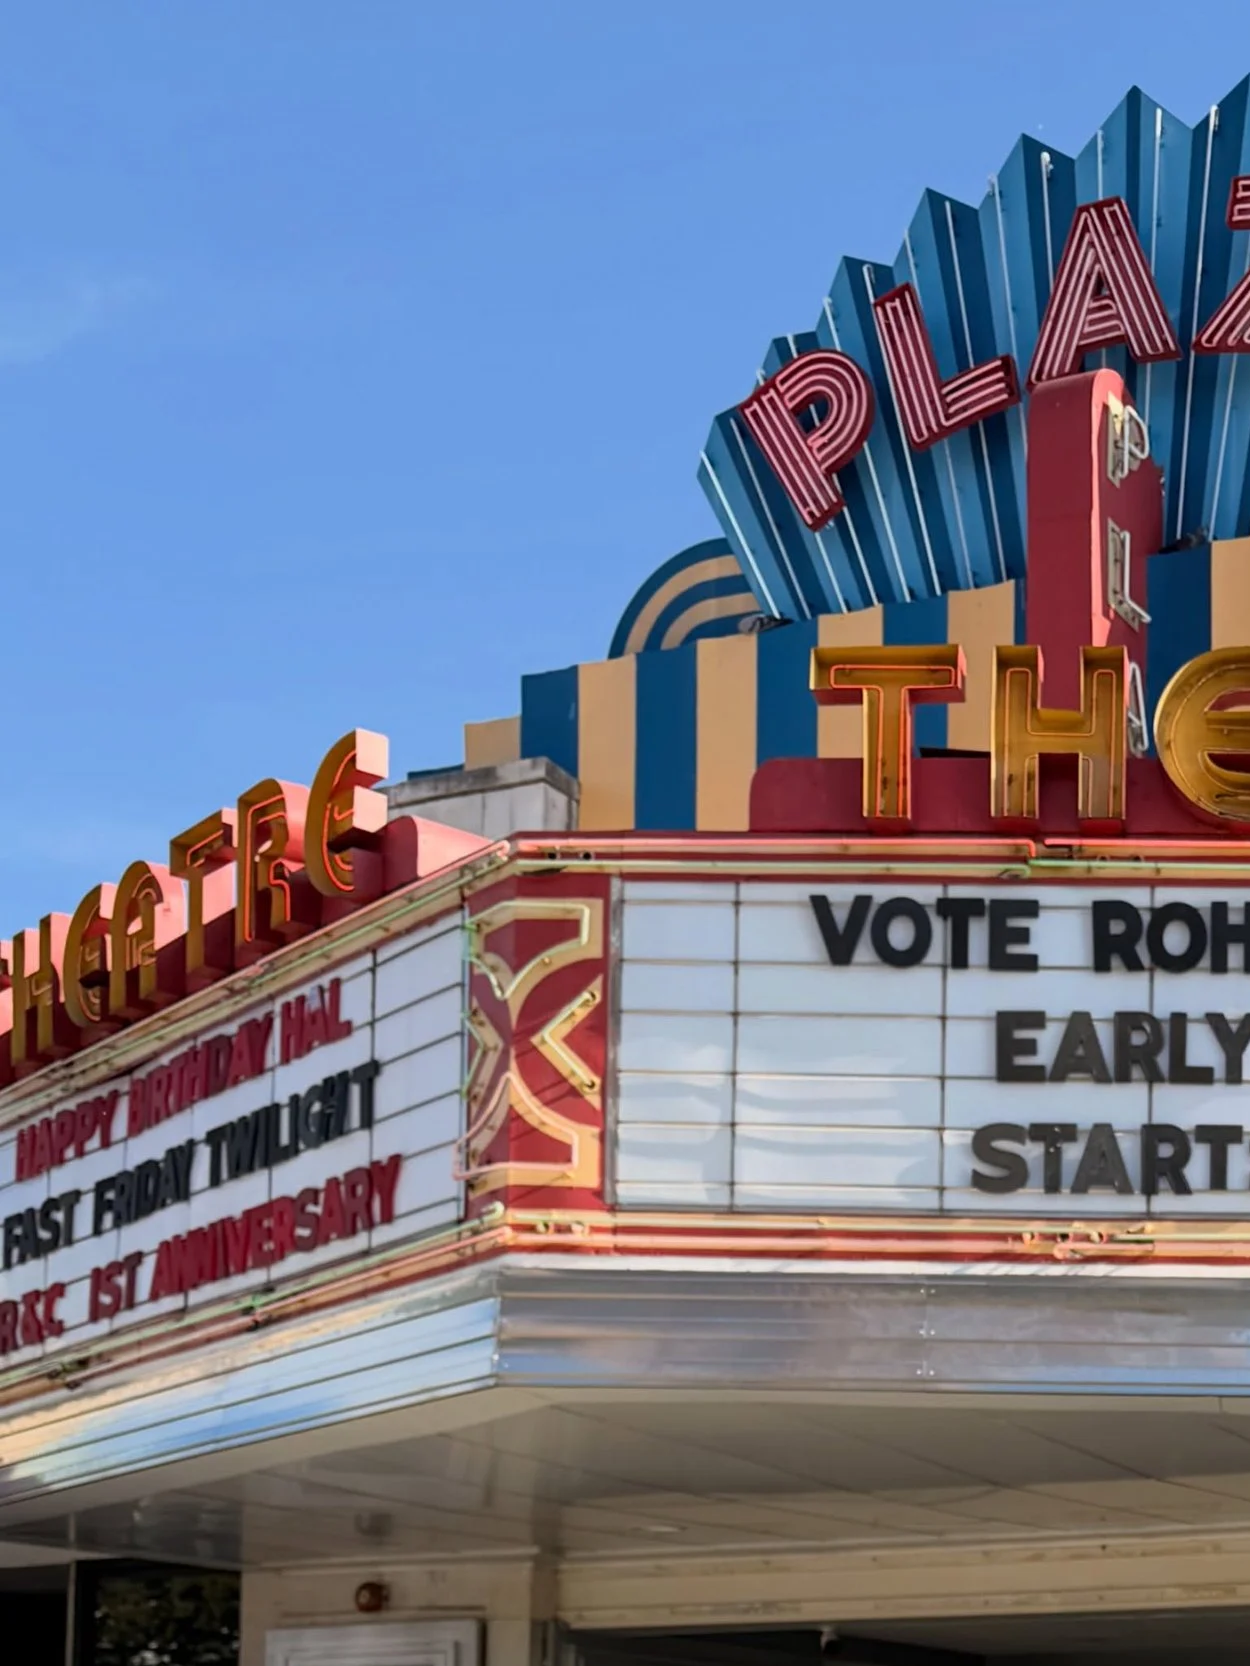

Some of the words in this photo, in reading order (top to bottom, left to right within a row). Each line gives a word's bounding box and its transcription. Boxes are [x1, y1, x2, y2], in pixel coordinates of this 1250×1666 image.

[0, 728, 389, 1068] HEATRE
[809, 894, 1040, 972] VOTE
[2, 1189, 81, 1270] FAST
[92, 1138, 195, 1237] FRIDAY
[206, 1059, 381, 1187] TWILIGHT
[15, 1089, 120, 1182] HAPPY
[127, 1011, 274, 1138] BIRTHDAY
[280, 978, 353, 1065] HAL
[89, 1250, 144, 1323] 1ST
[149, 1153, 403, 1301] ANNIVERSARY
